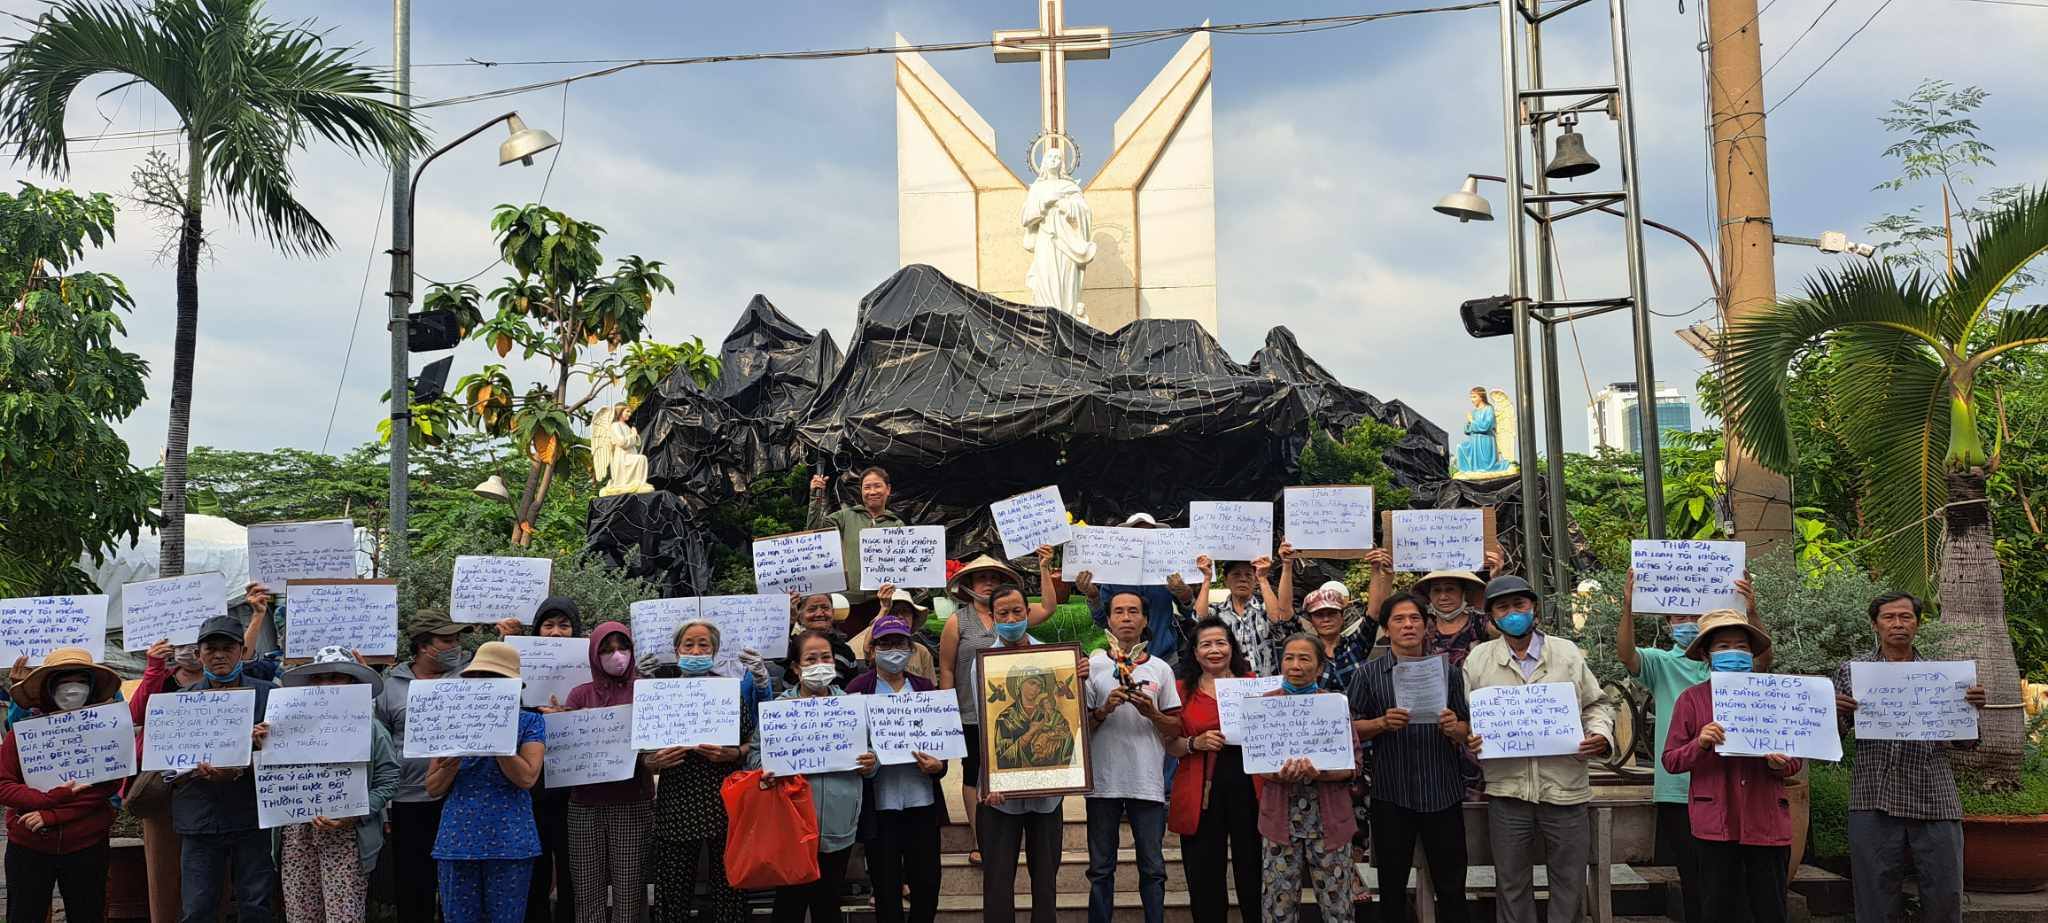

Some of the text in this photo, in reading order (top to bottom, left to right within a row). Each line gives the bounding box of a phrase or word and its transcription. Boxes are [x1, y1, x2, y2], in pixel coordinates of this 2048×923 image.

[1678, 551, 1692, 559] TÔI
[1698, 552, 1730, 561] KHÔNG
[1655, 596, 1701, 607] VRLH
[1526, 685, 1548, 694] 107
[1505, 696, 1520, 705] TÔI
[1797, 692, 1810, 701] TÔI
[805, 707, 819, 717] TÔI
[19, 729, 37, 740] TÔI
[914, 742, 944, 751] VRLH
[1745, 737, 1795, 752] VRLH
[59, 769, 94, 782] VRLH
[286, 807, 322, 818] VRLH
